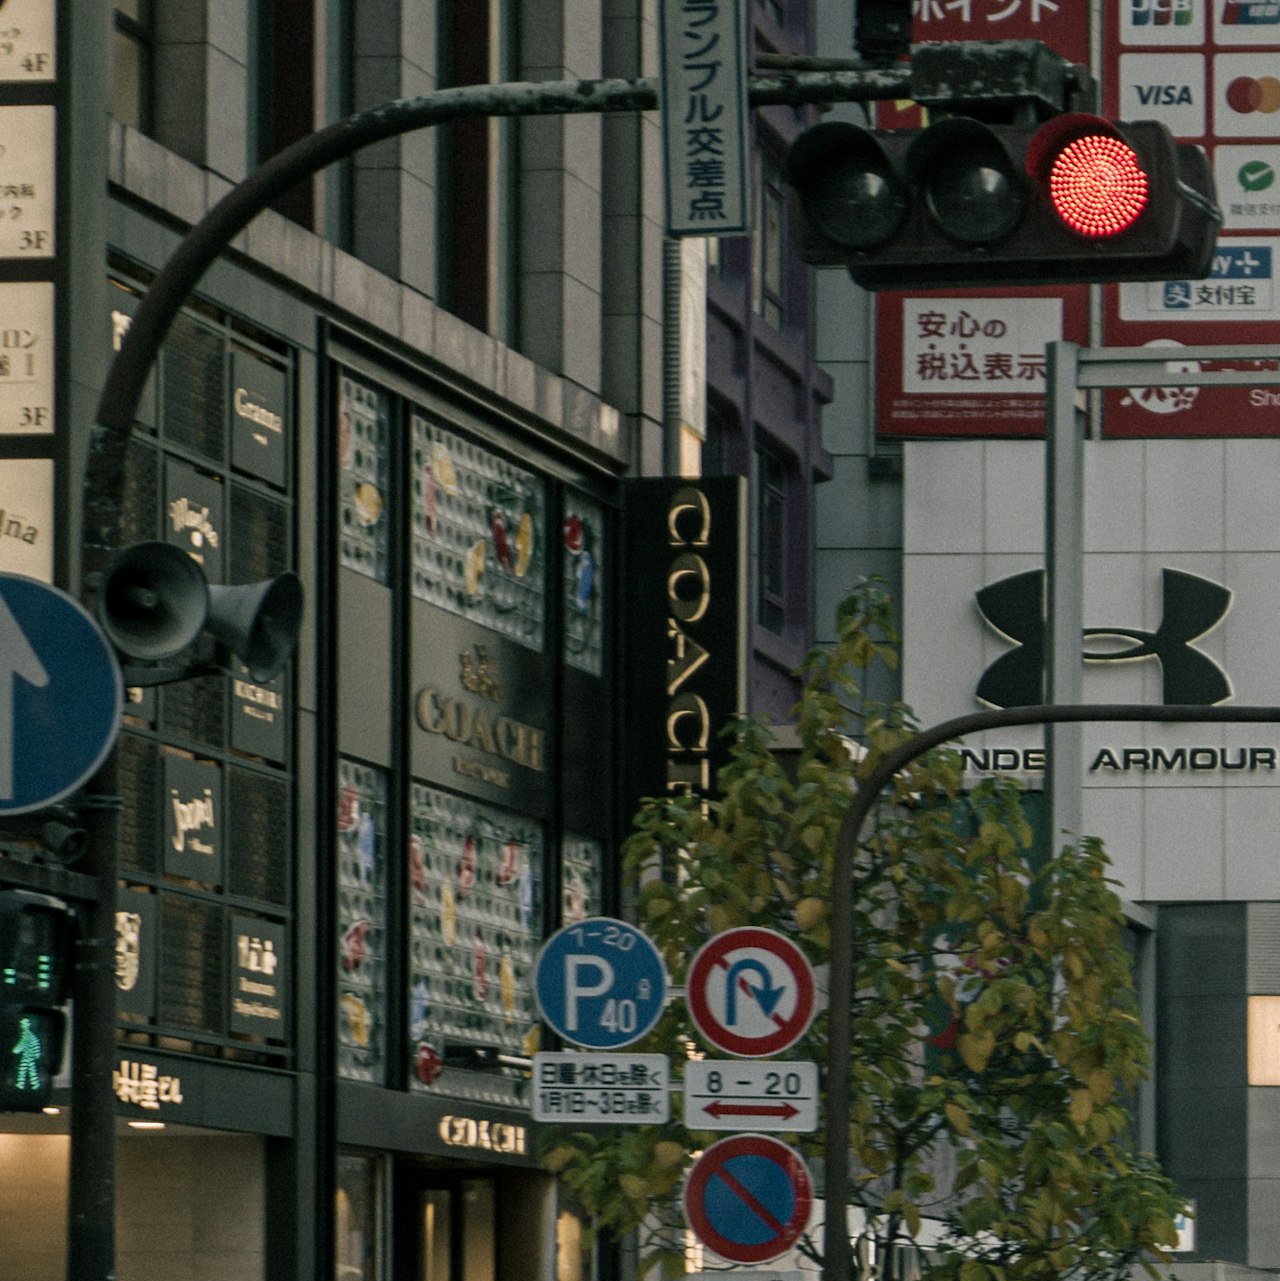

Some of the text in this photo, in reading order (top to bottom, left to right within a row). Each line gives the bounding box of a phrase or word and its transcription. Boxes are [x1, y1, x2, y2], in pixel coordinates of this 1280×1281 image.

[1133, 84, 1194, 105] VISA
[19, 230, 48, 250] 3F
[1195, 284, 1256, 305] 支付宝
[917, 311, 1006, 339] 安心の
[917, 352, 1046, 381] 税込表示
[18, 406, 49, 427] 3F
[960, 747, 1277, 772] NDE ARMOUR
[568, 926, 637, 951] 1-20
[564, 953, 615, 1032] P
[599, 999, 637, 1034] 40
[438, 1114, 526, 1156] COACH
